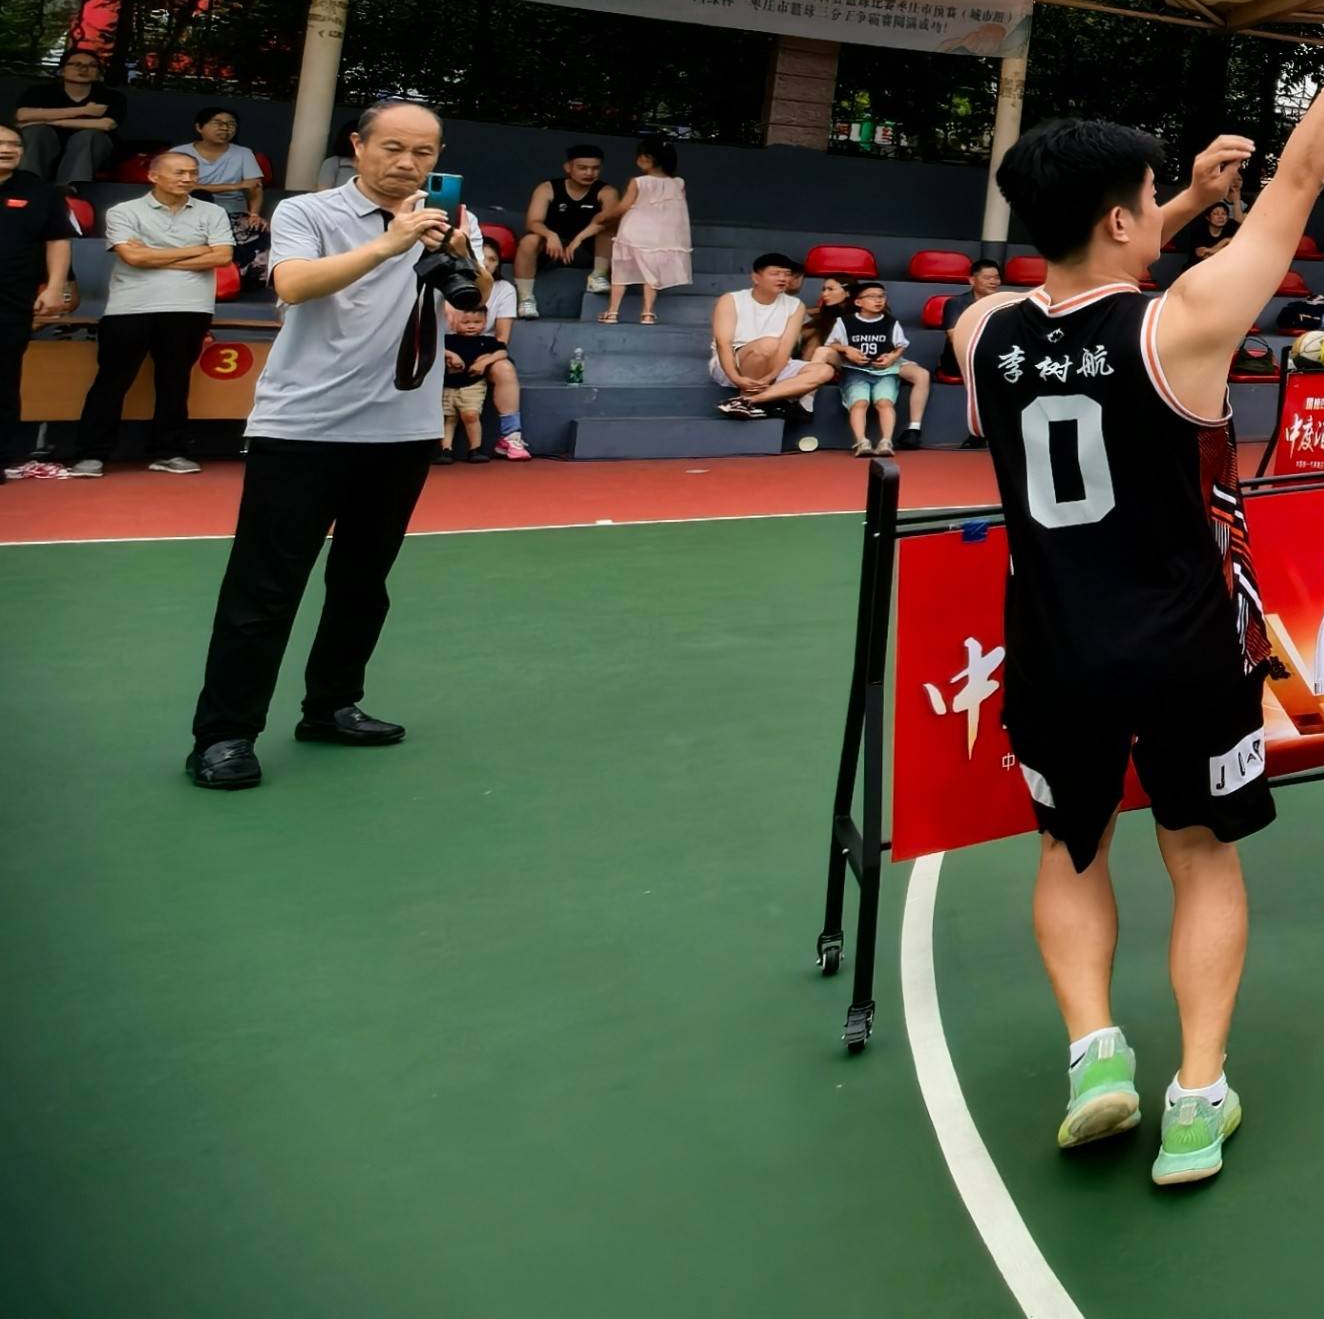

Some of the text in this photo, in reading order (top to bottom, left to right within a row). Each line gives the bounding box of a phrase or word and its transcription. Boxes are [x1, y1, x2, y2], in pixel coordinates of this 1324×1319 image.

[215, 349, 239, 373] 3
[860, 342, 878, 355] 09
[997, 344, 1115, 384] 李树航
[1021, 393, 1116, 529] 0
